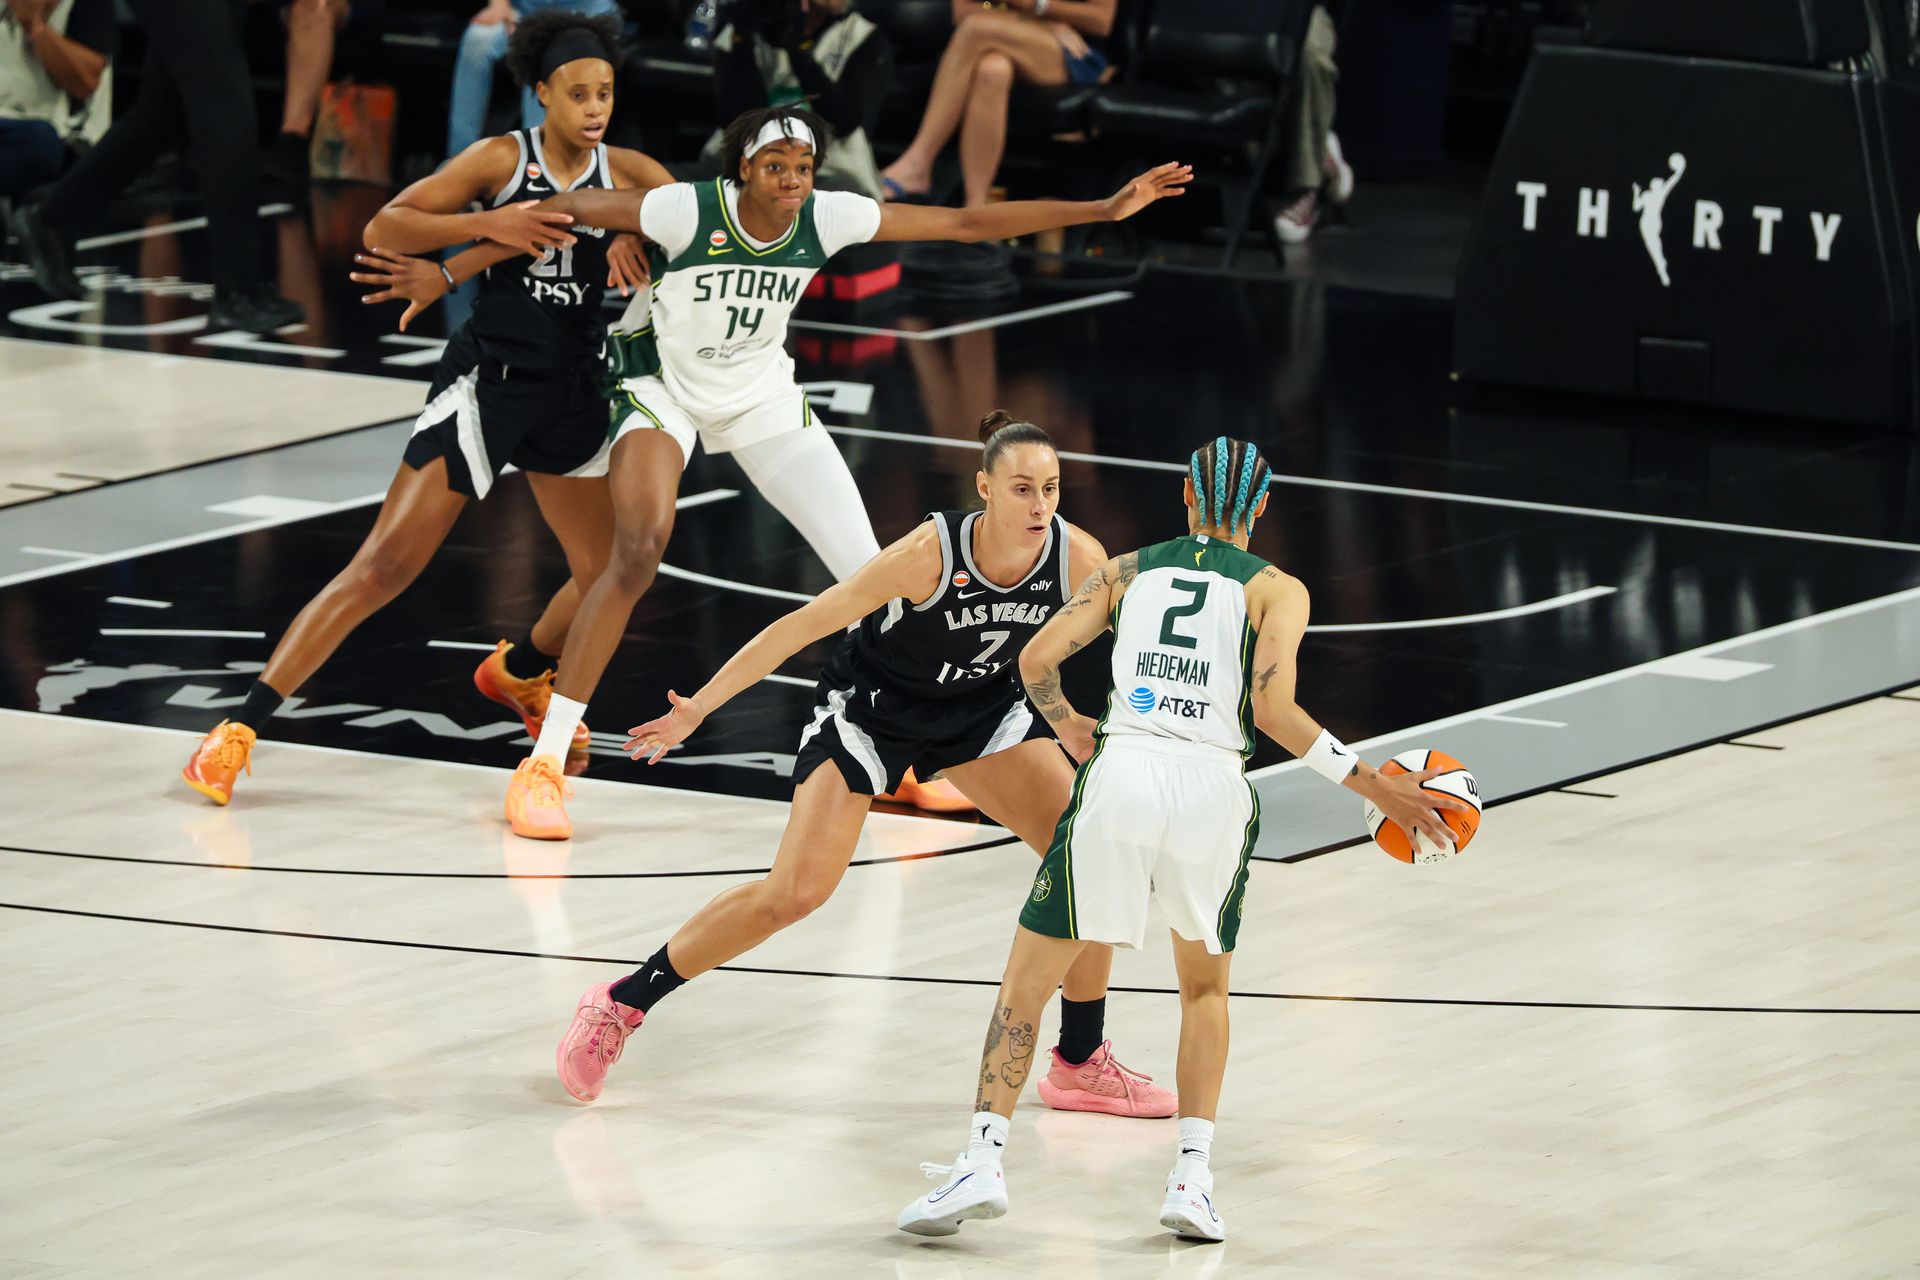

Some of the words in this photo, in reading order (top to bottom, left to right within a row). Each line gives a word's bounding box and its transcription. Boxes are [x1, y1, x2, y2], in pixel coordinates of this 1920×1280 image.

[528, 243, 573, 277] 21
[523, 276, 590, 306] PSY
[694, 269, 800, 305] STORM
[725, 305, 764, 340] 14
[1030, 579, 1053, 591] ally
[944, 604, 988, 631] LAS
[991, 602, 1050, 625] VEGAS
[1159, 578, 1210, 650] 2
[970, 630, 1011, 664] 7
[1136, 651, 1211, 687] HIEDEMAN
[1158, 695, 1211, 720] AT&T
